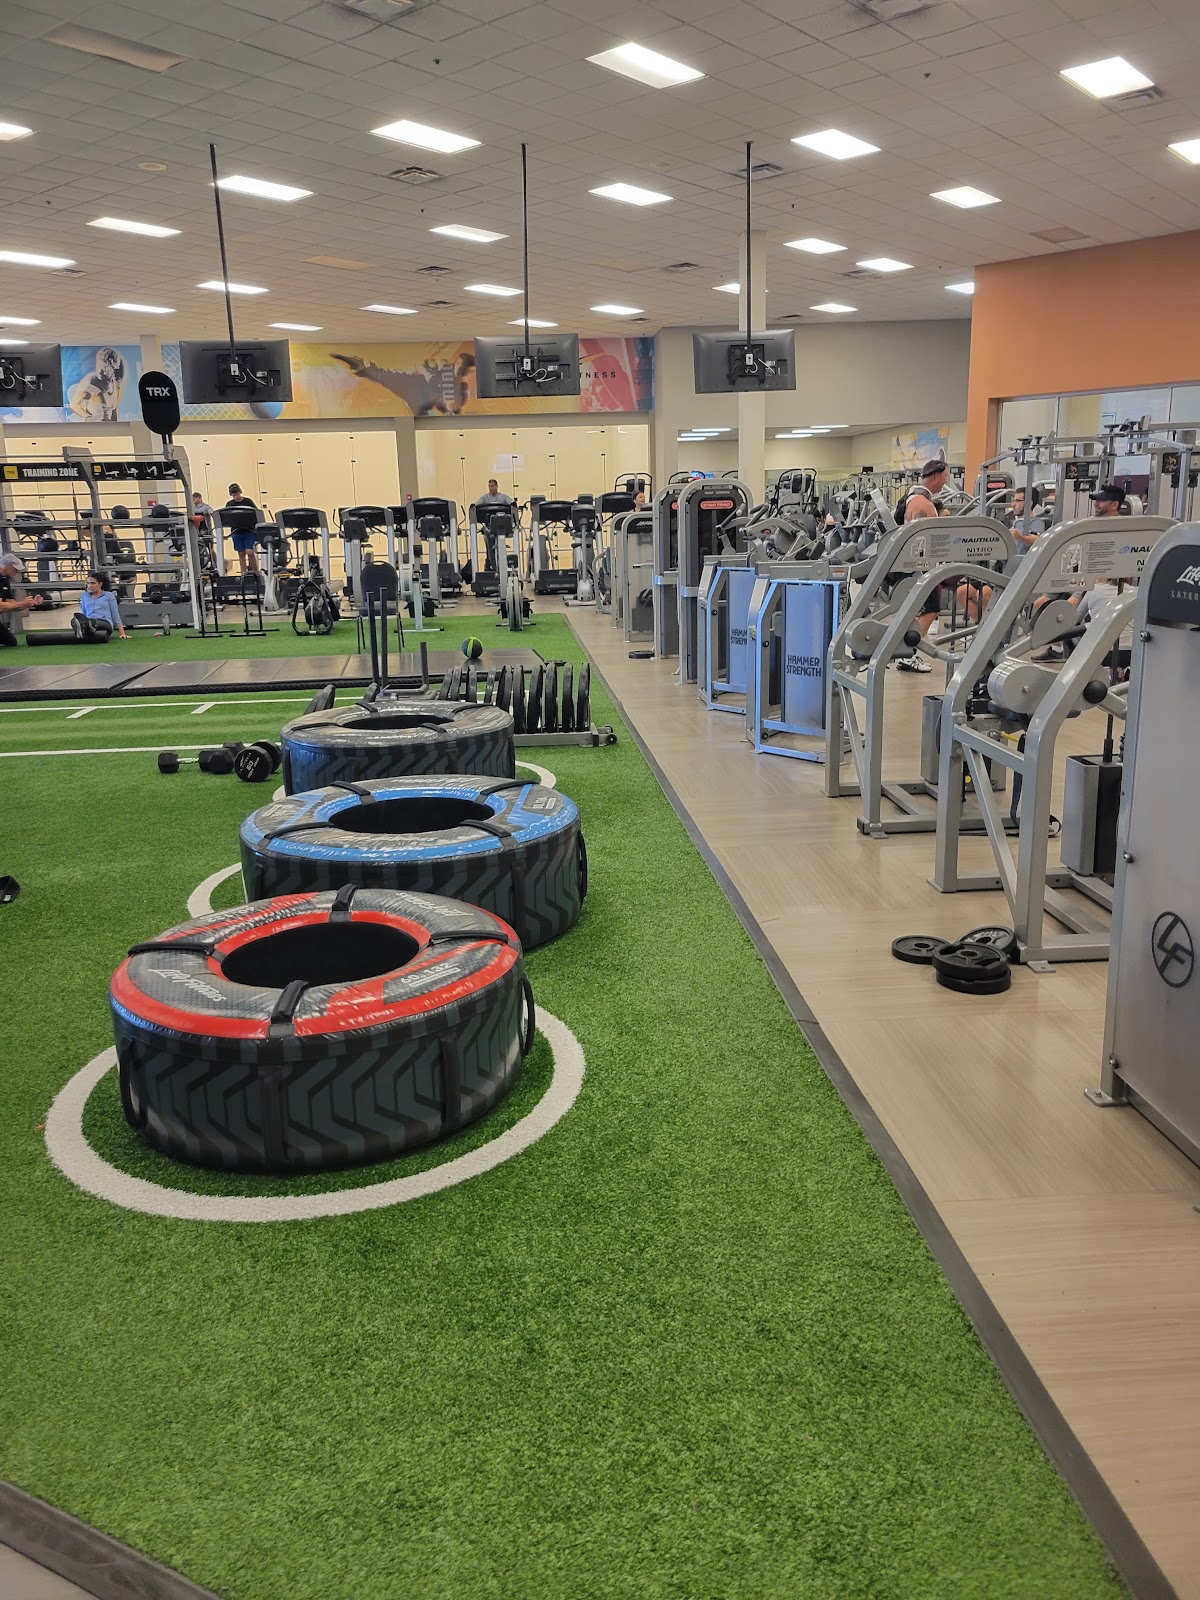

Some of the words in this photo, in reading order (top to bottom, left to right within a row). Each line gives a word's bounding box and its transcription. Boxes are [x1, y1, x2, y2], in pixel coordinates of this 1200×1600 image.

[579, 371, 616, 379] TNESS
[145, 386, 171, 396] TRX
[22, 468, 58, 477] TRAINING
[58, 467, 79, 477] ZONE
[961, 536, 1000, 544] NAUTILUS
[1171, 590, 1199, 600] LATER
[731, 628, 748, 637] HAMM
[730, 636, 748, 645] STREN
[787, 654, 820, 667] HAMMER
[786, 665, 822, 677] STRENGTH
[400, 962, 459, 984] 60.132
